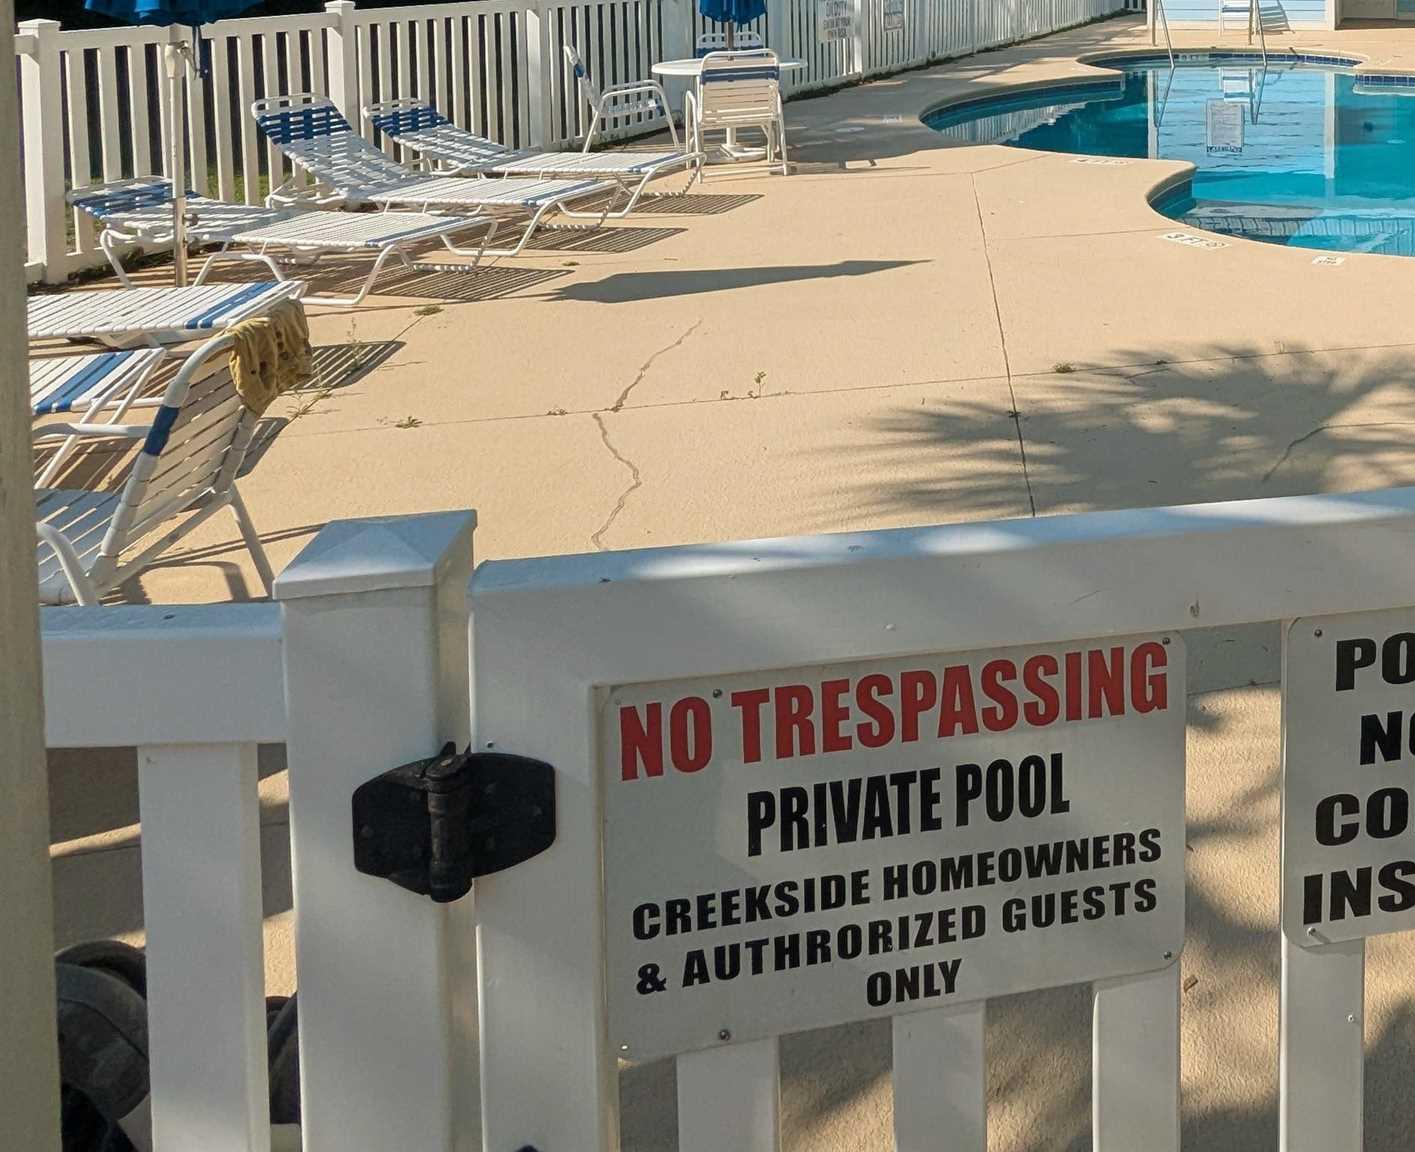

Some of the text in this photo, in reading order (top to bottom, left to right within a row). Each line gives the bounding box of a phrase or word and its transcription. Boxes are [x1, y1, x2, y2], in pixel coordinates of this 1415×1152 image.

[619, 641, 1169, 782] NO TRESPASSING
[747, 753, 1070, 858] PRIVATE POOL
[632, 828, 1163, 941] CREEKSIDE HOMEOWNERS
[636, 877, 1158, 996] & AUTHRORIZED GUESTS
[866, 958, 963, 1008] ONLY
